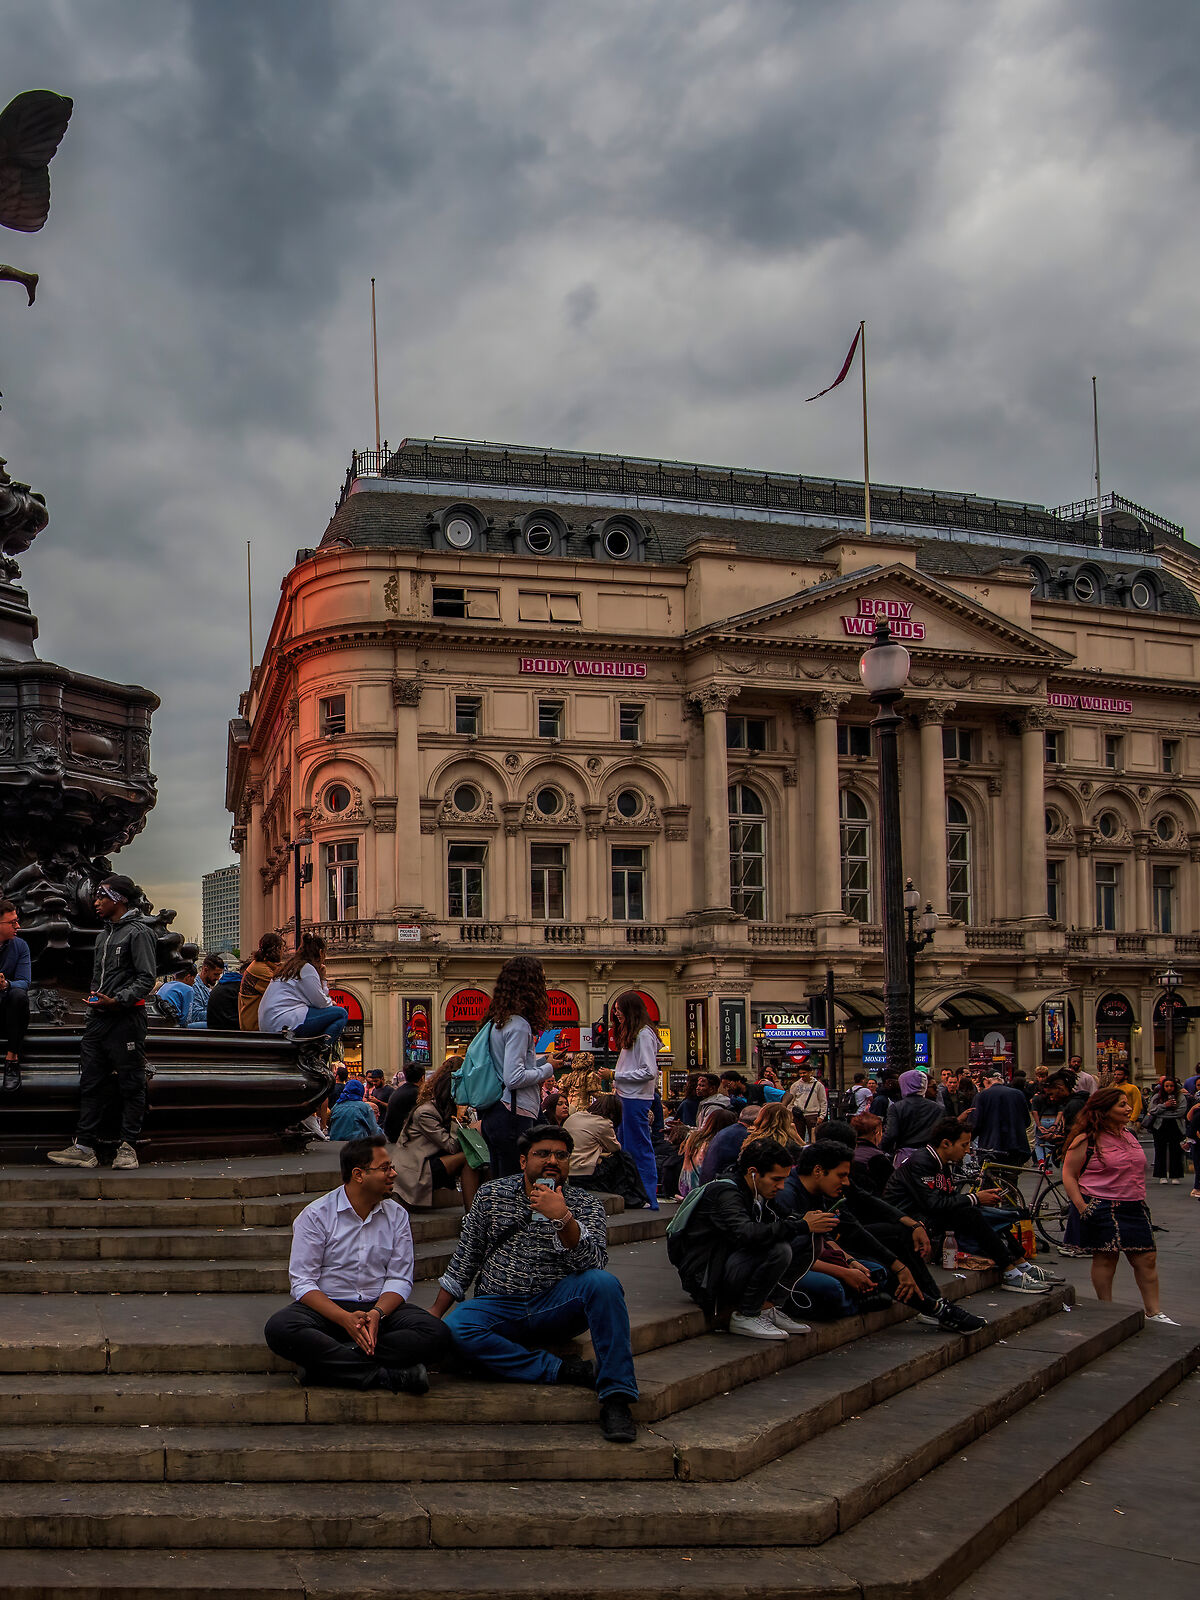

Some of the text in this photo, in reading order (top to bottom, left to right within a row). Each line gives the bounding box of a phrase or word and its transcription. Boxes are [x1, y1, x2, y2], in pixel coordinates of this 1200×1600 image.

[859, 598, 914, 619] BODY
[844, 616, 926, 639] WOLDS
[520, 657, 647, 677] BODY WORLDS
[1080, 695, 1133, 713] WORLDS
[456, 994, 484, 1005] LONDON
